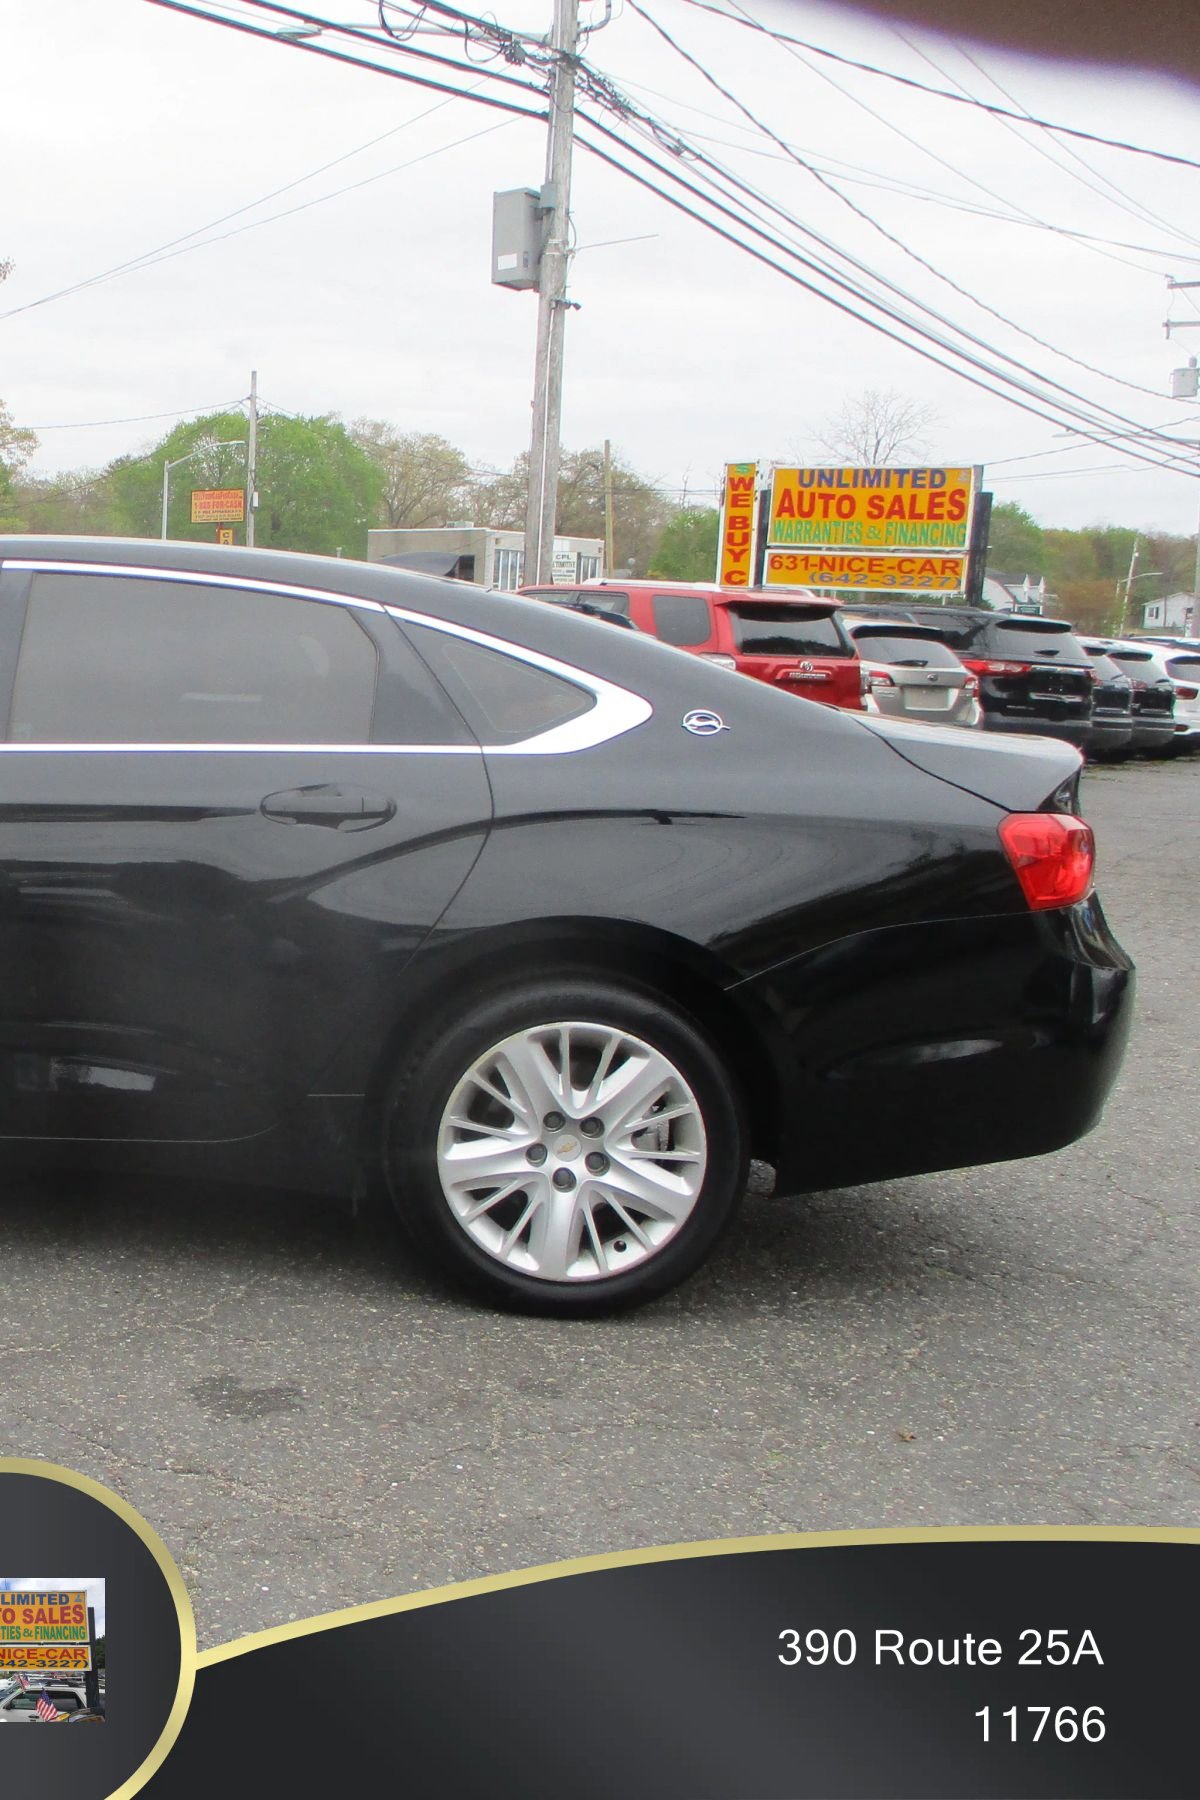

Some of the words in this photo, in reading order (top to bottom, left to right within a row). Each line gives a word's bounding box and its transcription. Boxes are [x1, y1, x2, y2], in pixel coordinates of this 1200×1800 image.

[729, 476, 755, 508] WE
[799, 469, 946, 489] UNLIMITED
[776, 488, 856, 519] AUTO
[866, 488, 966, 521] SALES
[726, 515, 750, 562] BUY
[774, 520, 863, 544] WARRANTIES
[866, 525, 882, 540] &
[884, 522, 966, 546] FINANCING
[770, 555, 960, 575] 631-NICE-CAR
[809, 572, 962, 589] (642-3227)
